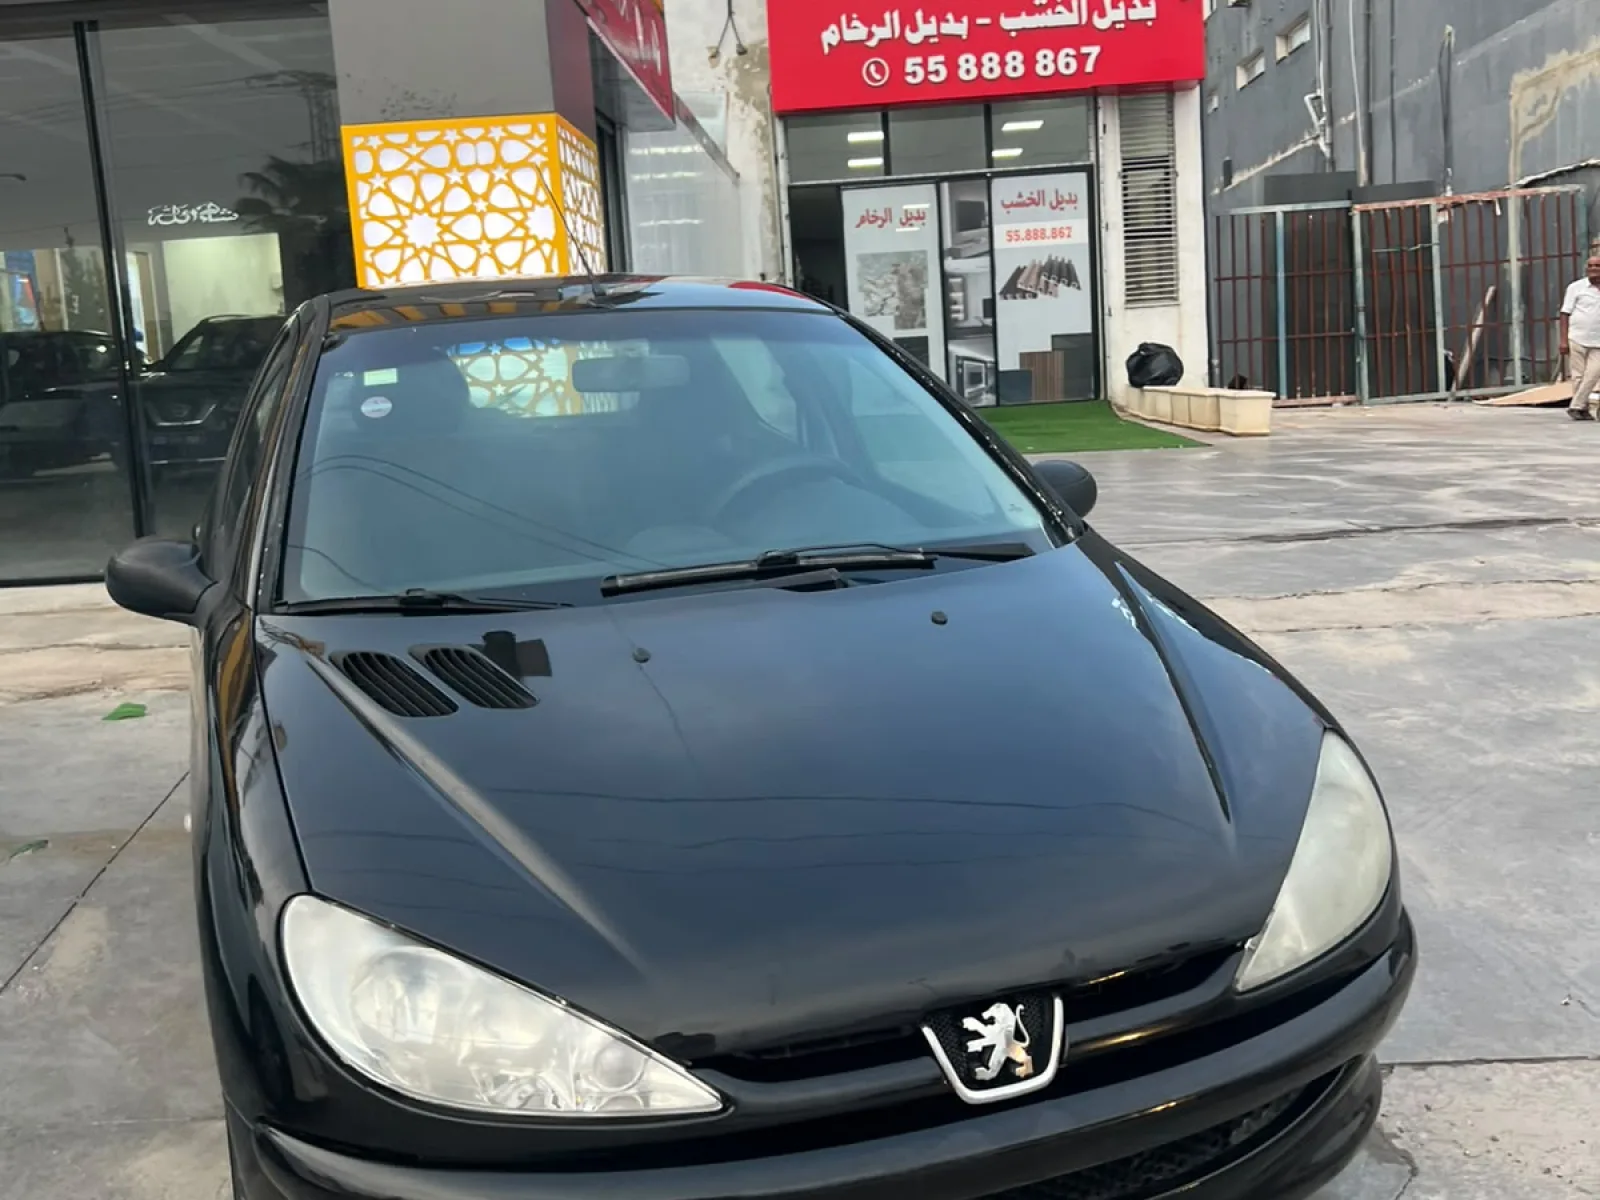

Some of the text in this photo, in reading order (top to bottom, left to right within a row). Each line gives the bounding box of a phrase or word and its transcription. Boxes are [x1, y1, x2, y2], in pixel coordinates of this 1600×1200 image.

[904, 8, 969, 45] بديل
[1092, 0, 1157, 30] بديل
[820, 8, 901, 56] الرخام
[903, 45, 1102, 85] 55 888 867
[854, 206, 927, 229] بديل الرخام
[1000, 188, 1079, 215] بديل الخشب
